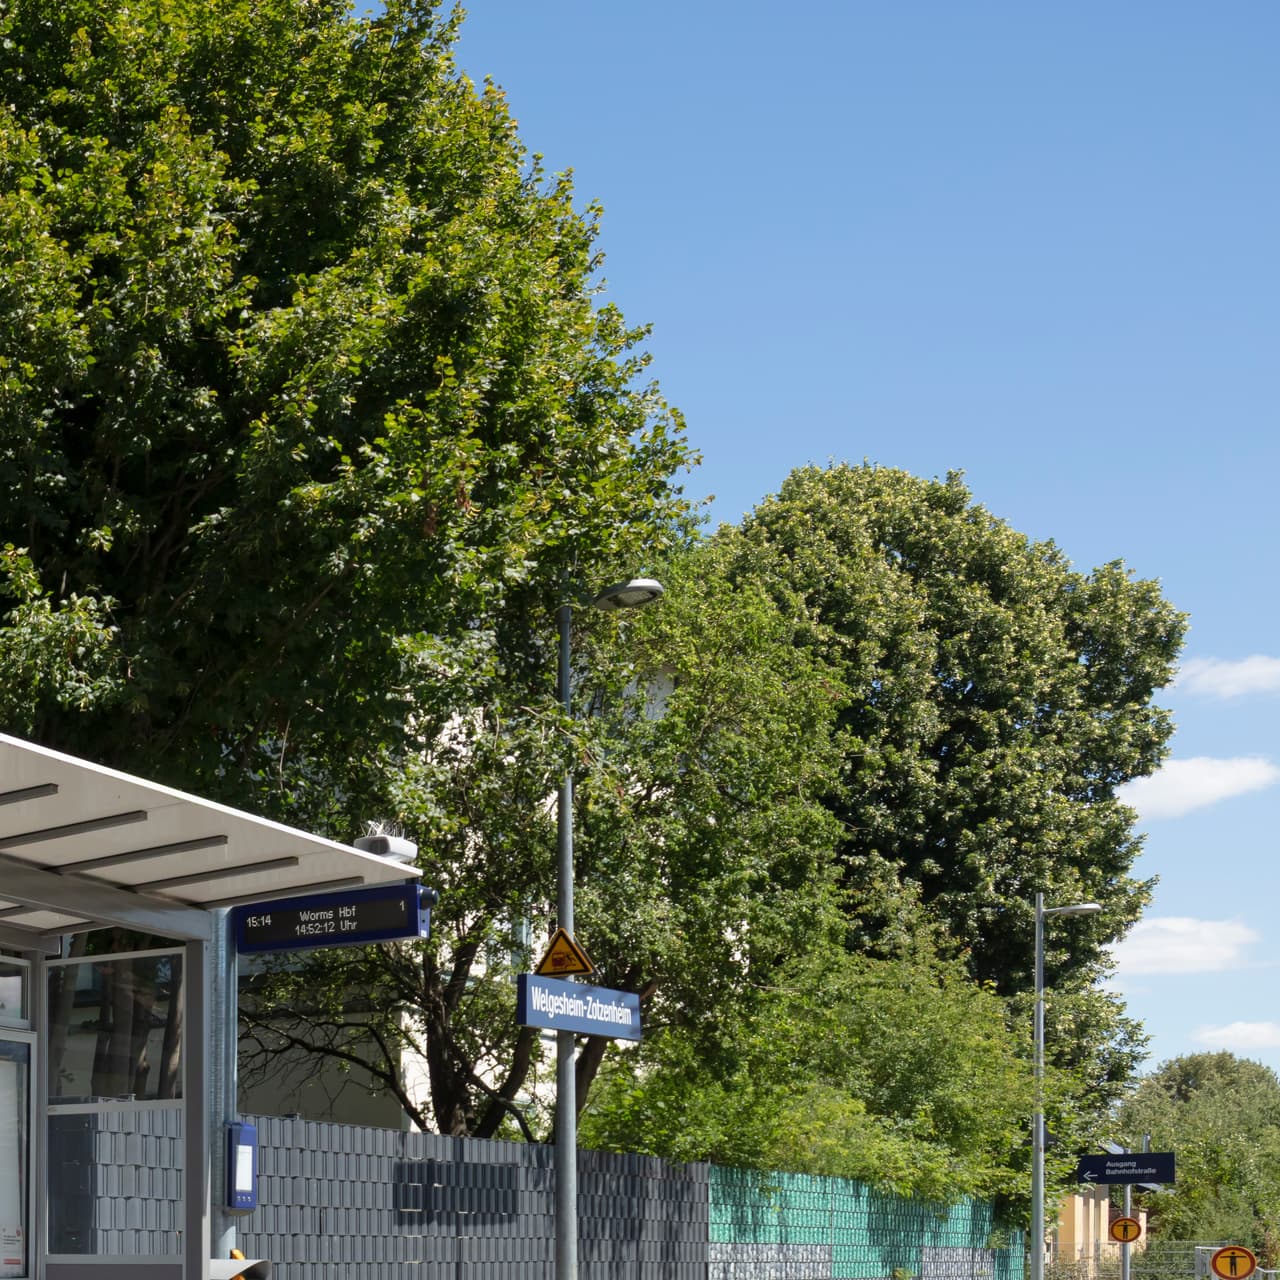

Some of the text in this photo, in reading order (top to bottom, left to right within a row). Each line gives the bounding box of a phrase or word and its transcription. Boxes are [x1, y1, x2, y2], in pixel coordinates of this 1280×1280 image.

[246, 900, 405, 928] 15:14 Worms Hbf 1
[294, 920, 358, 936] 14:52:12 Uhr
[531, 986, 632, 1025] Welgesheim-Zotzenheim
